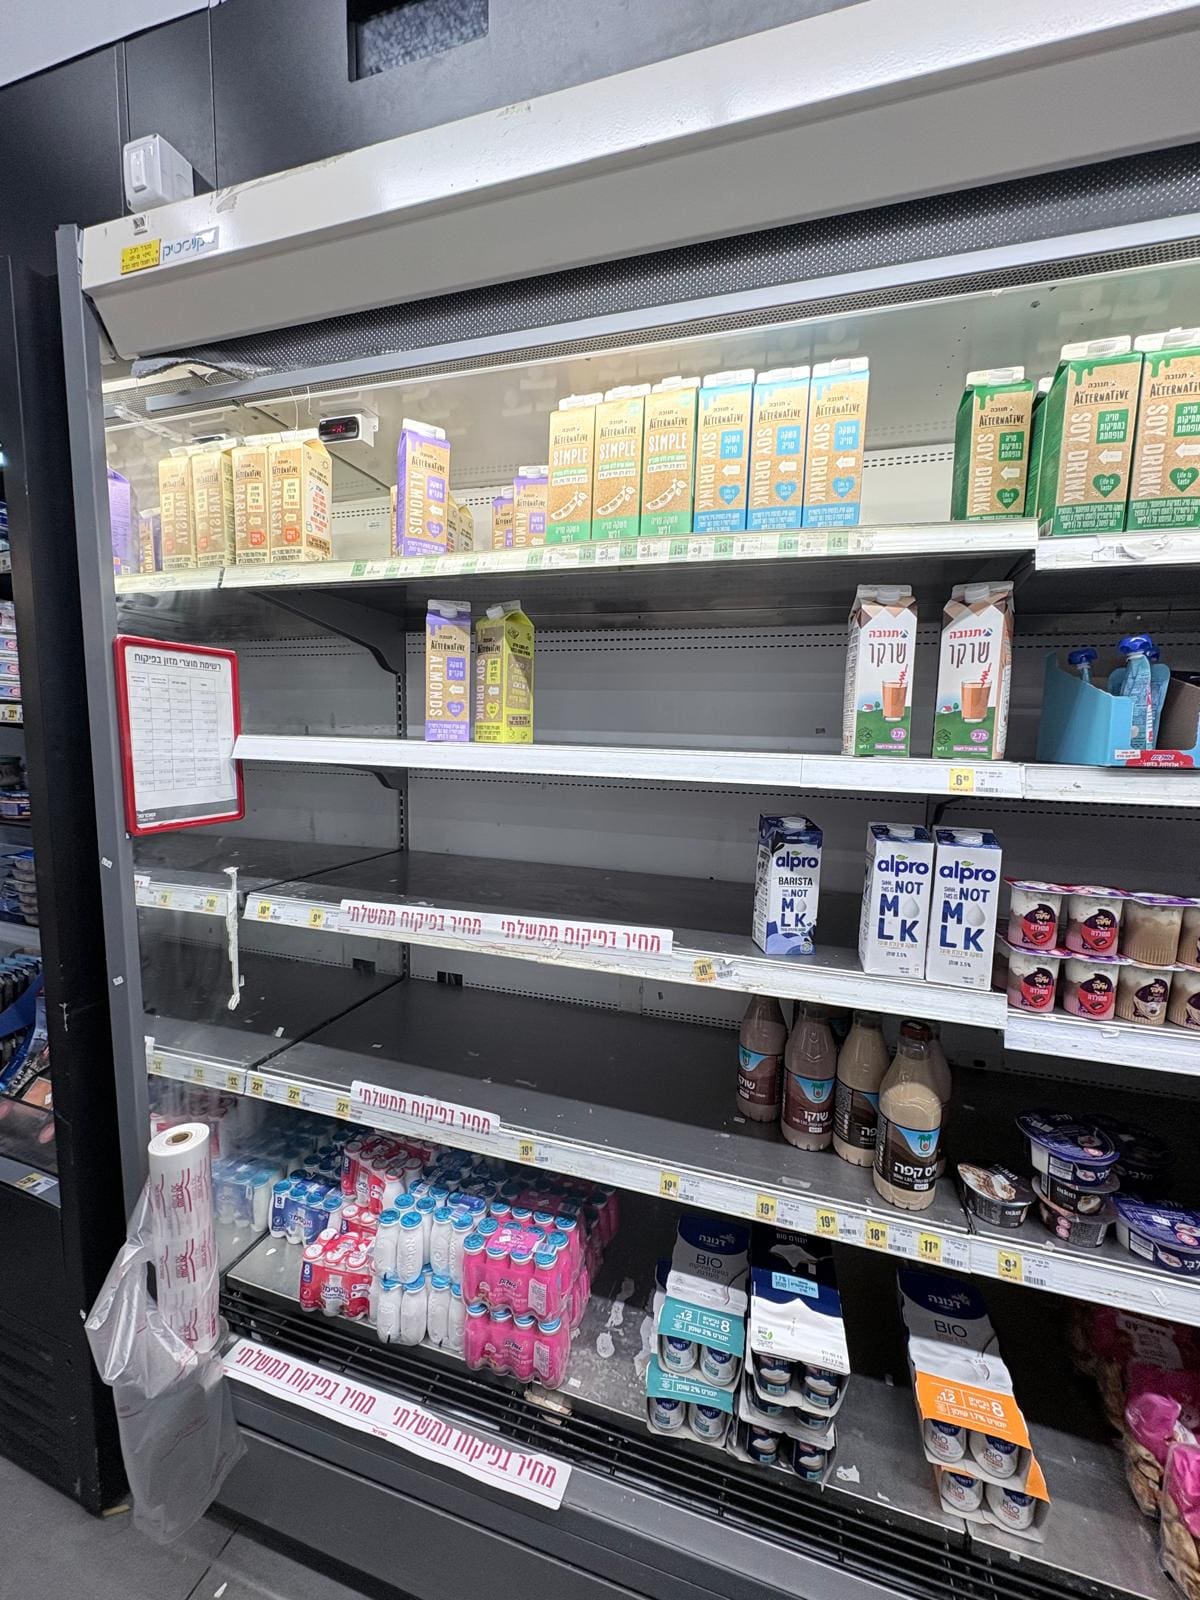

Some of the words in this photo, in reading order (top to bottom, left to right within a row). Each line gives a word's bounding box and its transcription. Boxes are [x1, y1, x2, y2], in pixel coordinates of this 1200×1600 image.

[1069, 411, 1092, 443] SOY
[1105, 413, 1119, 422] סויה
[1145, 404, 1169, 437] SOY
[813, 423, 830, 450] SOY
[839, 425, 855, 434] משקה
[600, 440, 636, 460] SIMPLE
[649, 432, 687, 452] SIMPLE
[702, 433, 717, 459] SOY
[756, 428, 772, 454] SOY
[840, 437, 852, 445] סויה
[977, 433, 994, 461] SOY
[553, 448, 588, 466] SIMPLE
[809, 455, 828, 502] DRINK
[1064, 449, 1088, 502] DRINK
[1138, 443, 1165, 497] DRINK
[699, 464, 715, 508] DRINK
[753, 460, 771, 506] DRINK
[973, 467, 992, 513] DRINK
[235, 480, 247, 544] BARISTA
[271, 479, 282, 536] BARISTA
[409, 470, 424, 535] ALMONDS
[868, 629, 899, 638] תנובה
[950, 628, 982, 639] תנובה
[134, 653, 162, 665] בפיקוח
[163, 656, 178, 667] מזון
[179, 658, 198, 668] מוצרי
[199, 660, 221, 670] רשימת
[869, 642, 906, 667] שוקו
[950, 641, 990, 668] שוקו
[477, 659, 486, 682] SOY
[430, 655, 443, 717] ALMONDS
[476, 685, 485, 720] DRINK
[776, 851, 819, 871] alpro
[877, 855, 929, 877] alpro
[778, 877, 813, 886] BARISTA
[939, 861, 996, 884] alpro
[791, 889, 808, 897] NOT
[895, 881, 924, 895] NOT
[959, 888, 990, 902] NOT
[348, 904, 396, 927] ממשלתי
[400, 911, 445, 932] בפיקוח
[450, 916, 482, 935] מחיר
[501, 919, 558, 943] ממשלתי
[565, 927, 617, 949] בפיקוח
[623, 931, 661, 952] מחיר
[359, 1087, 407, 1114] ממשלתי
[410, 1099, 455, 1124] בפיקוח
[804, 1110, 829, 1122] שוקו
[460, 1111, 491, 1135] מחיר
[894, 1162, 923, 1179] קפה
[699, 1234, 726, 1247] דנונה
[304, 1264, 310, 1275] 8
[695, 1254, 723, 1269] BIO
[927, 1294, 961, 1309] דנונה
[688, 1324, 702, 1334] שומן
[720, 1320, 730, 1333] 8
[934, 1320, 968, 1338] BIO
[712, 1333, 729, 1342] יוגורט
[235, 1346, 290, 1382] ממשלתי
[286, 1366, 341, 1402] בפיקוח
[676, 1383, 690, 1392] שומן
[689, 1385, 700, 1394] 2%
[700, 1388, 717, 1398] יוגורט
[340, 1387, 377, 1416] מחיר
[991, 1401, 1005, 1418] 8
[393, 1404, 453, 1449] ממשלתי
[454, 1430, 516, 1471] בפיקוח
[515, 1454, 558, 1489] מחיר
